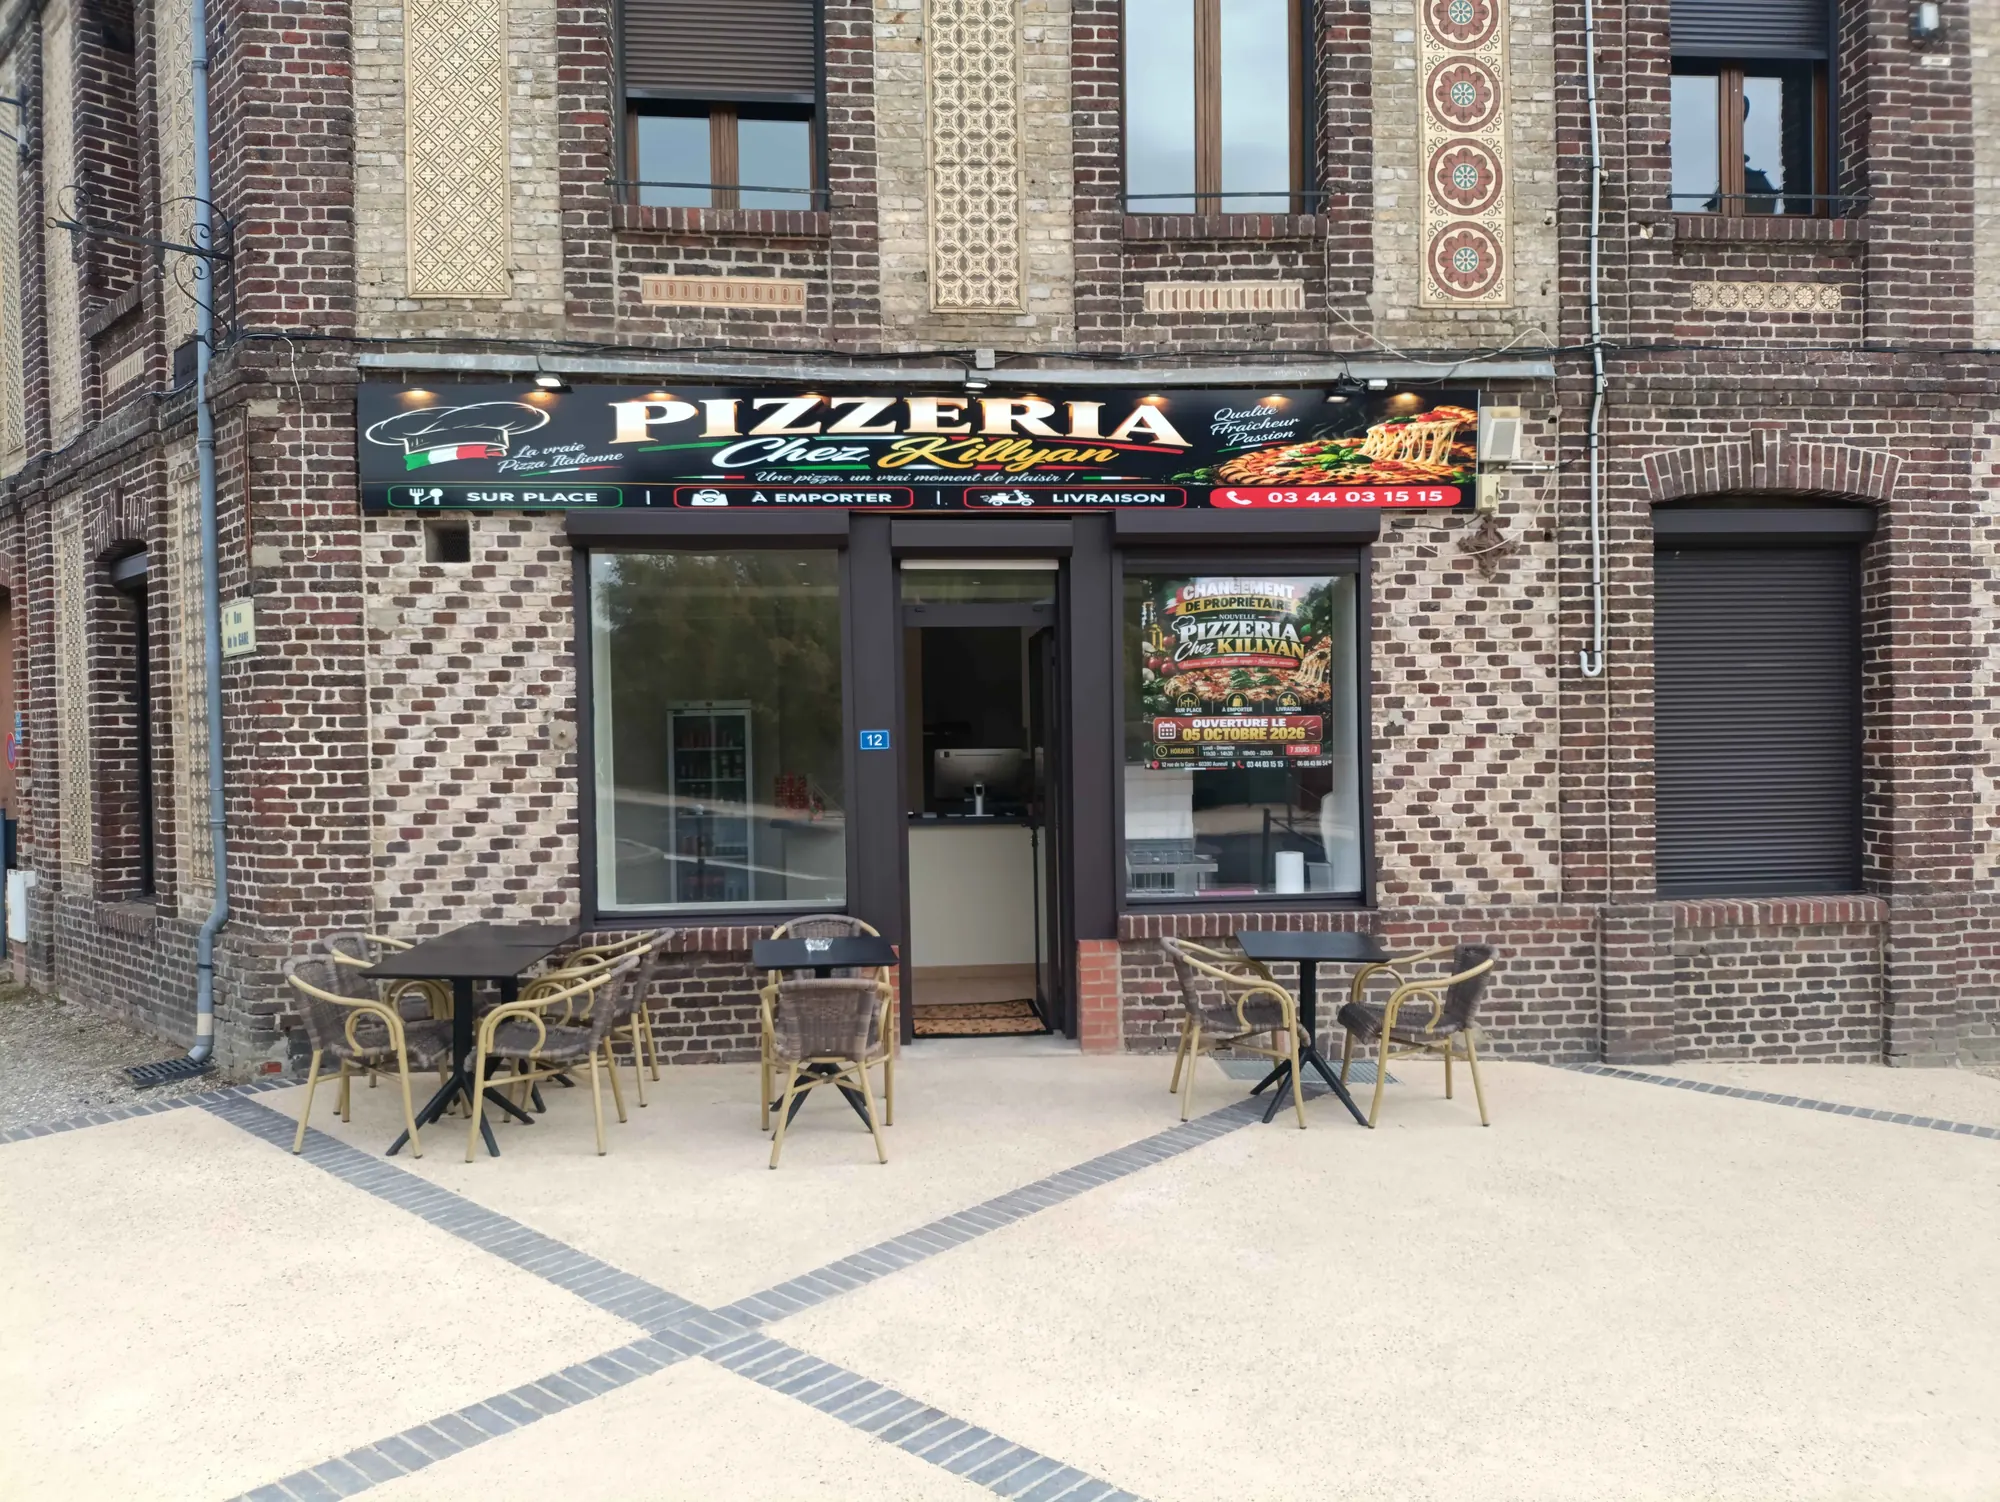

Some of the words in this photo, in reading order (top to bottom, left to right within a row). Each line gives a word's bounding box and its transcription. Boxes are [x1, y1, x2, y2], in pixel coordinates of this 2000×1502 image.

[608, 396, 1193, 447] PIZZERIA
[1214, 404, 1279, 422] Qualité
[1210, 417, 1300, 436] Fraîcheur
[1226, 430, 1296, 447] Passion
[513, 445, 539, 459] La
[542, 442, 586, 455] vraie
[712, 437, 871, 469] Chez
[876, 436, 1120, 473] Killyan
[497, 458, 548, 474] Pizza
[549, 452, 625, 468] Italienne
[755, 471, 793, 483] Une
[793, 472, 844, 485] pizza,
[849, 474, 872, 483] un
[876, 472, 911, 482] vrai
[914, 472, 981, 482] moment
[982, 471, 1005, 482] de
[1000, 471, 1061, 485] plaisir
[1065, 471, 1075, 482] !
[466, 490, 516, 504] SUR
[523, 490, 599, 504] PLACE
[751, 488, 769, 504] À
[774, 490, 893, 504] EMPORTER
[1053, 491, 1166, 504] LIVRAISON
[1267, 490, 1298, 503] 03
[1307, 490, 1339, 503] 44
[1345, 489, 1375, 503] 03
[1382, 489, 1409, 503] 15
[1415, 489, 1443, 503] 15
[1182, 579, 1295, 600] CHANGEMENT
[1185, 600, 1201, 613] DE
[1203, 595, 1292, 610] PROPRIÉTAIRE
[1179, 620, 1301, 643] PIZZERIA
[1174, 640, 1216, 662] Chez
[1217, 637, 1305, 659] KILLYAN
[1192, 718, 1270, 728] OUVERTURE
[1272, 718, 1286, 727] LE
[866, 734, 883, 746] 12
[1182, 728, 1201, 741] 05
[1203, 727, 1267, 741] OCTOBRE
[1269, 727, 1306, 740] 2026
[1170, 747, 1195, 755] HORAIRES
[1246, 760, 1254, 768] 03
[1254, 760, 1262, 768] 44
[1262, 760, 1270, 768] 03
[1270, 760, 1276, 768] 15
[1277, 760, 1284, 768] 15
